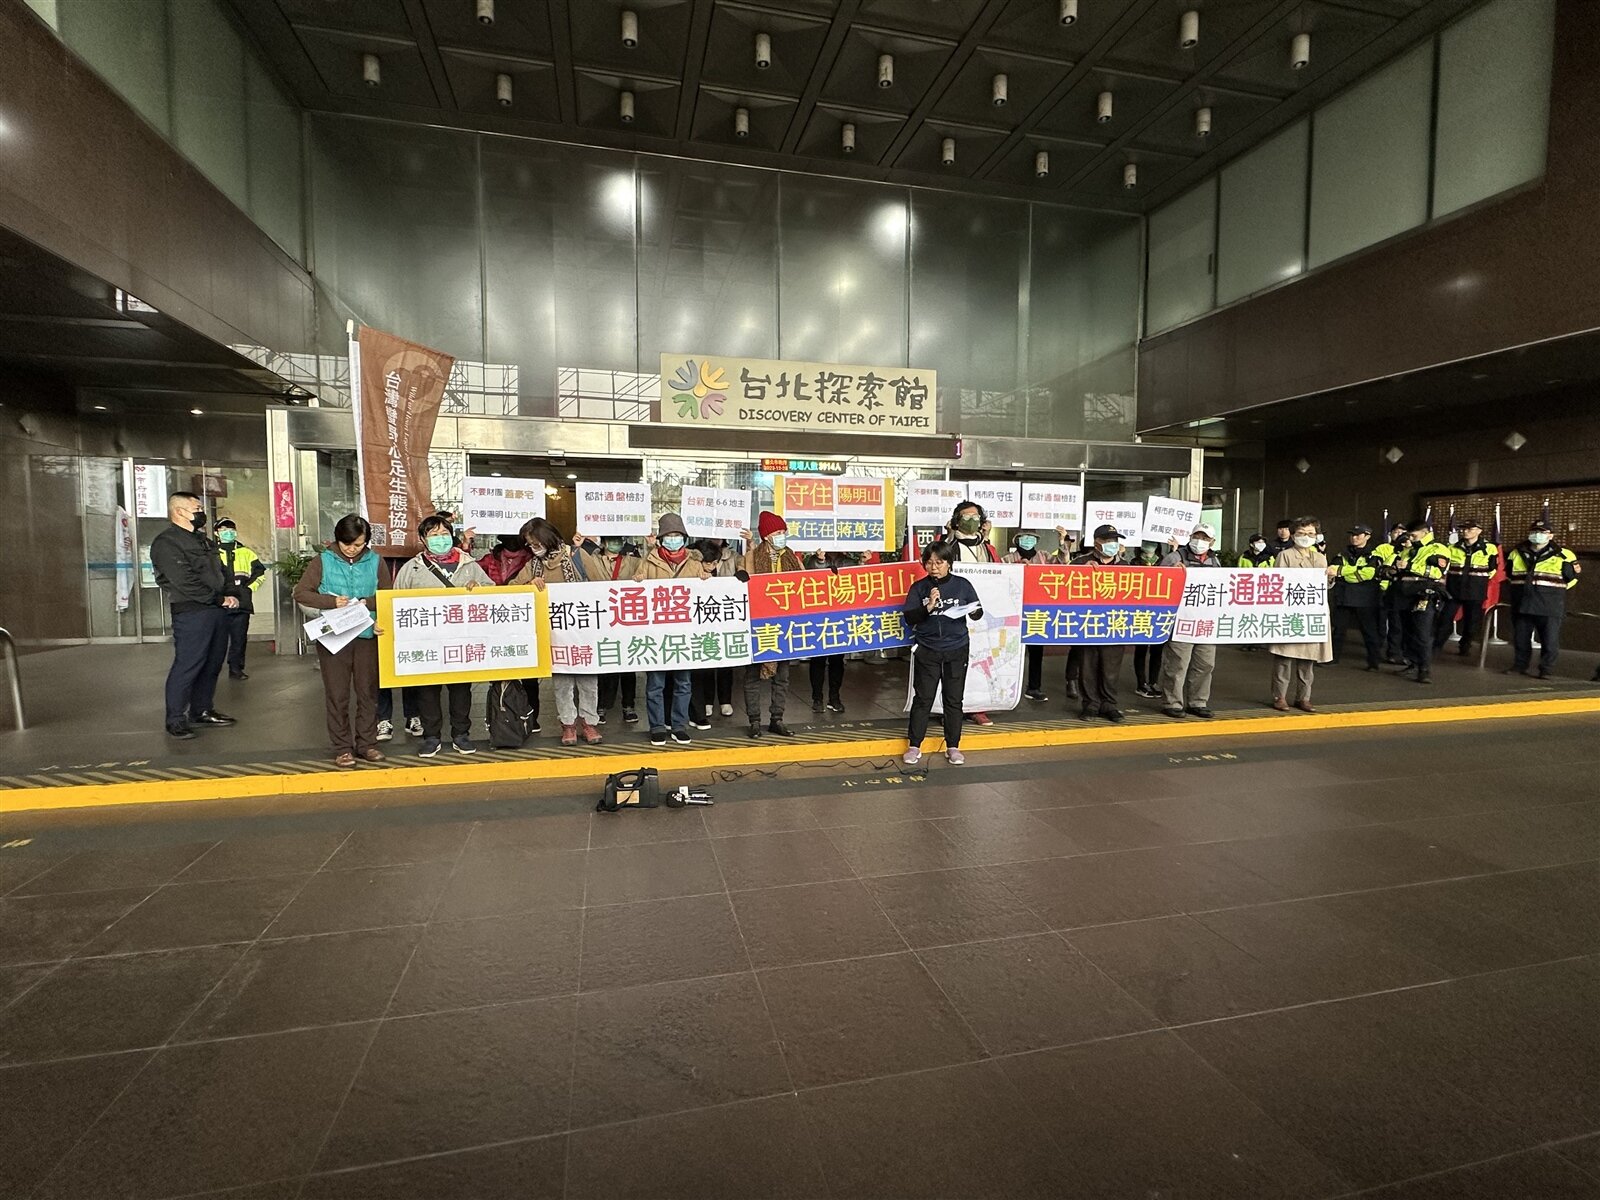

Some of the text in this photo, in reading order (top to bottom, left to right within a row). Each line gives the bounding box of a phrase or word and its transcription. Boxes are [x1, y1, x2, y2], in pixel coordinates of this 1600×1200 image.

[740, 367, 929, 411] 台北探索館
[739, 408, 930, 428] DISCOVERY CENTER OF TAIPEI
[956, 441, 961, 456] 1
[786, 482, 881, 508] 守住 陽明山
[765, 569, 915, 611] 守住陽明山
[1038, 570, 1172, 600] 守住陽明山
[1183, 573, 1326, 608] 都計通盤檢討
[395, 602, 532, 629] 都計通盤檢討
[548, 585, 749, 631] 都計通盤檢討
[1022, 608, 1176, 639] 責任在蔣萬安
[751, 611, 912, 657] 責任在蔣萬
